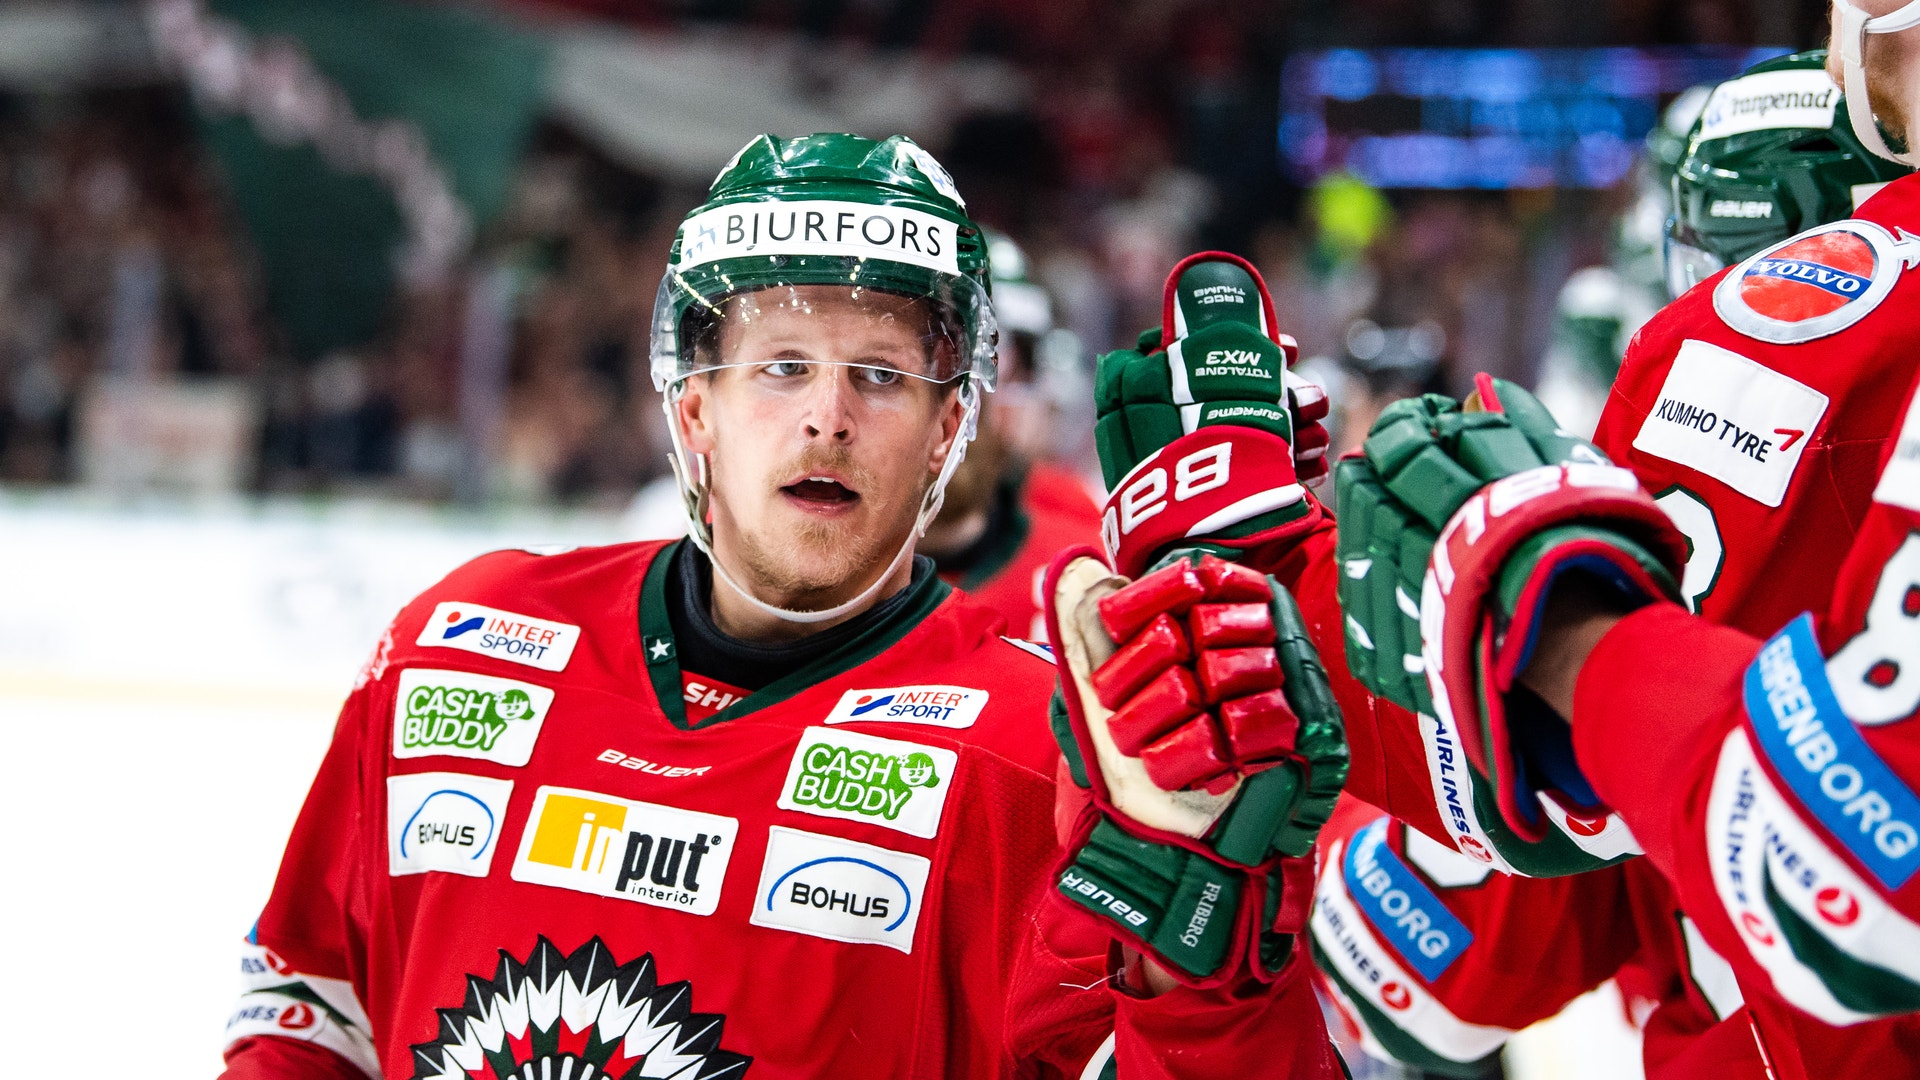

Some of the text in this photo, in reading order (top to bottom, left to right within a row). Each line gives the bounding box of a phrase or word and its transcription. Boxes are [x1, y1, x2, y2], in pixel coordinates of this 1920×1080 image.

[725, 211, 942, 257] BJURFORS
[1193, 285, 1246, 298] THUMB
[1759, 261, 1861, 293] VOLVO
[1195, 366, 1272, 379] TOTALONE
[1206, 350, 1262, 366] MX3
[1656, 398, 1772, 463] KUMHO TYRE
[488, 617, 554, 645] INTER
[480, 633, 548, 661] SPORT
[408, 688, 489, 719] CASH
[683, 682, 743, 711] SH
[896, 691, 963, 706] INTER
[887, 704, 955, 721] SPORT
[405, 717, 504, 749] BUDDY
[806, 747, 893, 785] CASH
[1435, 720, 1471, 834] AIRLINES
[796, 774, 908, 817] BUDDY
[418, 822, 475, 847] BOHUS
[571, 812, 710, 893] input
[790, 881, 889, 918] BOHUS
[1179, 882, 1222, 948] FRIBERG
